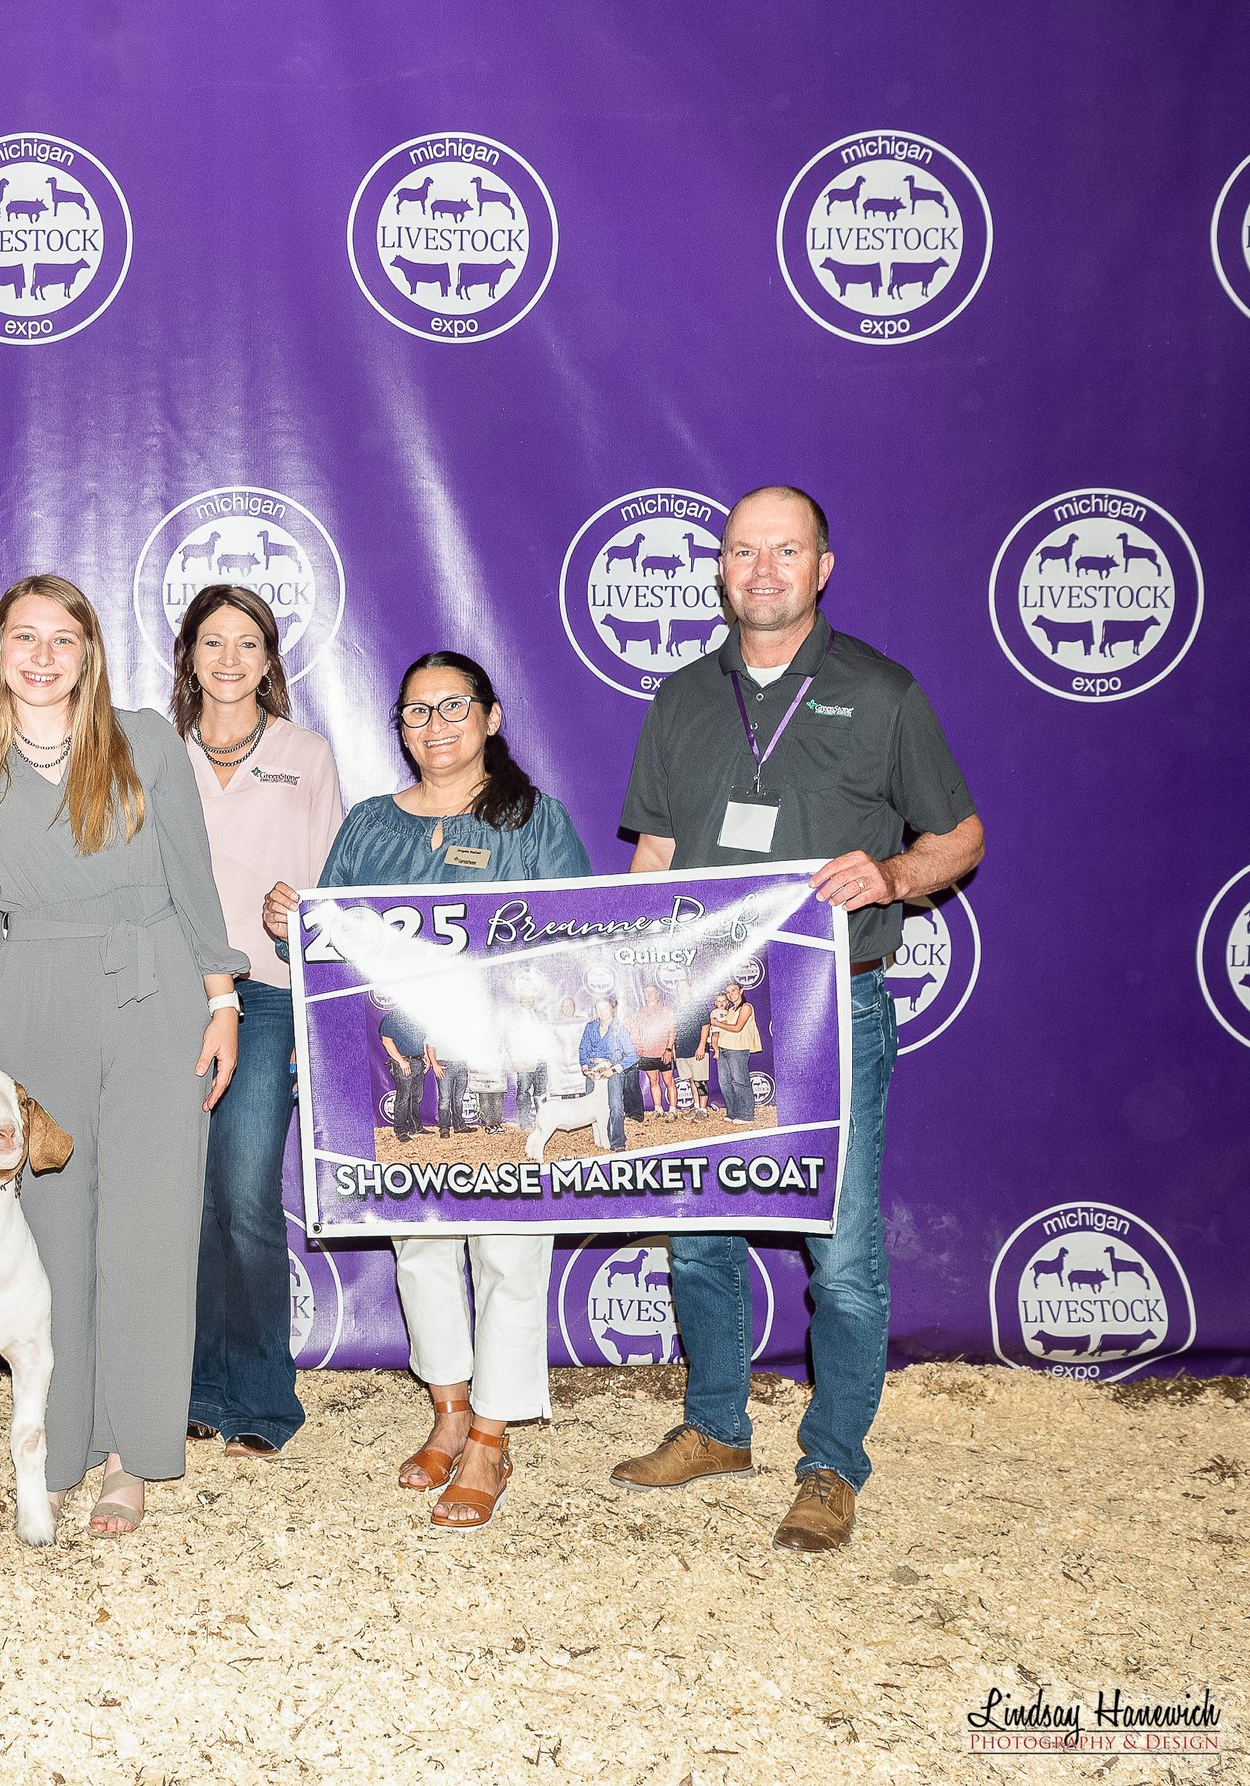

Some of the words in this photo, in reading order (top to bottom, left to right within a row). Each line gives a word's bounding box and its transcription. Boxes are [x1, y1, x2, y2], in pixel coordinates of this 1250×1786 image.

[408, 138, 500, 166] michigan
[840, 136, 933, 165] michigan
[380, 225, 526, 252] LIVESTOCK
[810, 227, 960, 251] LIVESTOCK
[4, 318, 53, 338] expo
[430, 317, 479, 338] expo
[860, 315, 910, 337] expo
[195, 492, 287, 520] michigan
[620, 494, 713, 522] michigan
[1053, 494, 1148, 522] michigan
[1022, 585, 1172, 609] LIVESTOCK
[1072, 676, 1122, 696] expo
[486, 899, 653, 946] Breanne
[614, 946, 698, 966] Quincy
[336, 1163, 542, 1197] SHOWCASE
[552, 1157, 710, 1193] MARKET
[717, 1156, 824, 1190] GOAT
[1042, 1207, 1130, 1235] michigan
[1023, 1298, 1165, 1325] LIVESTOCK
[1052, 1365, 1100, 1381] expo
